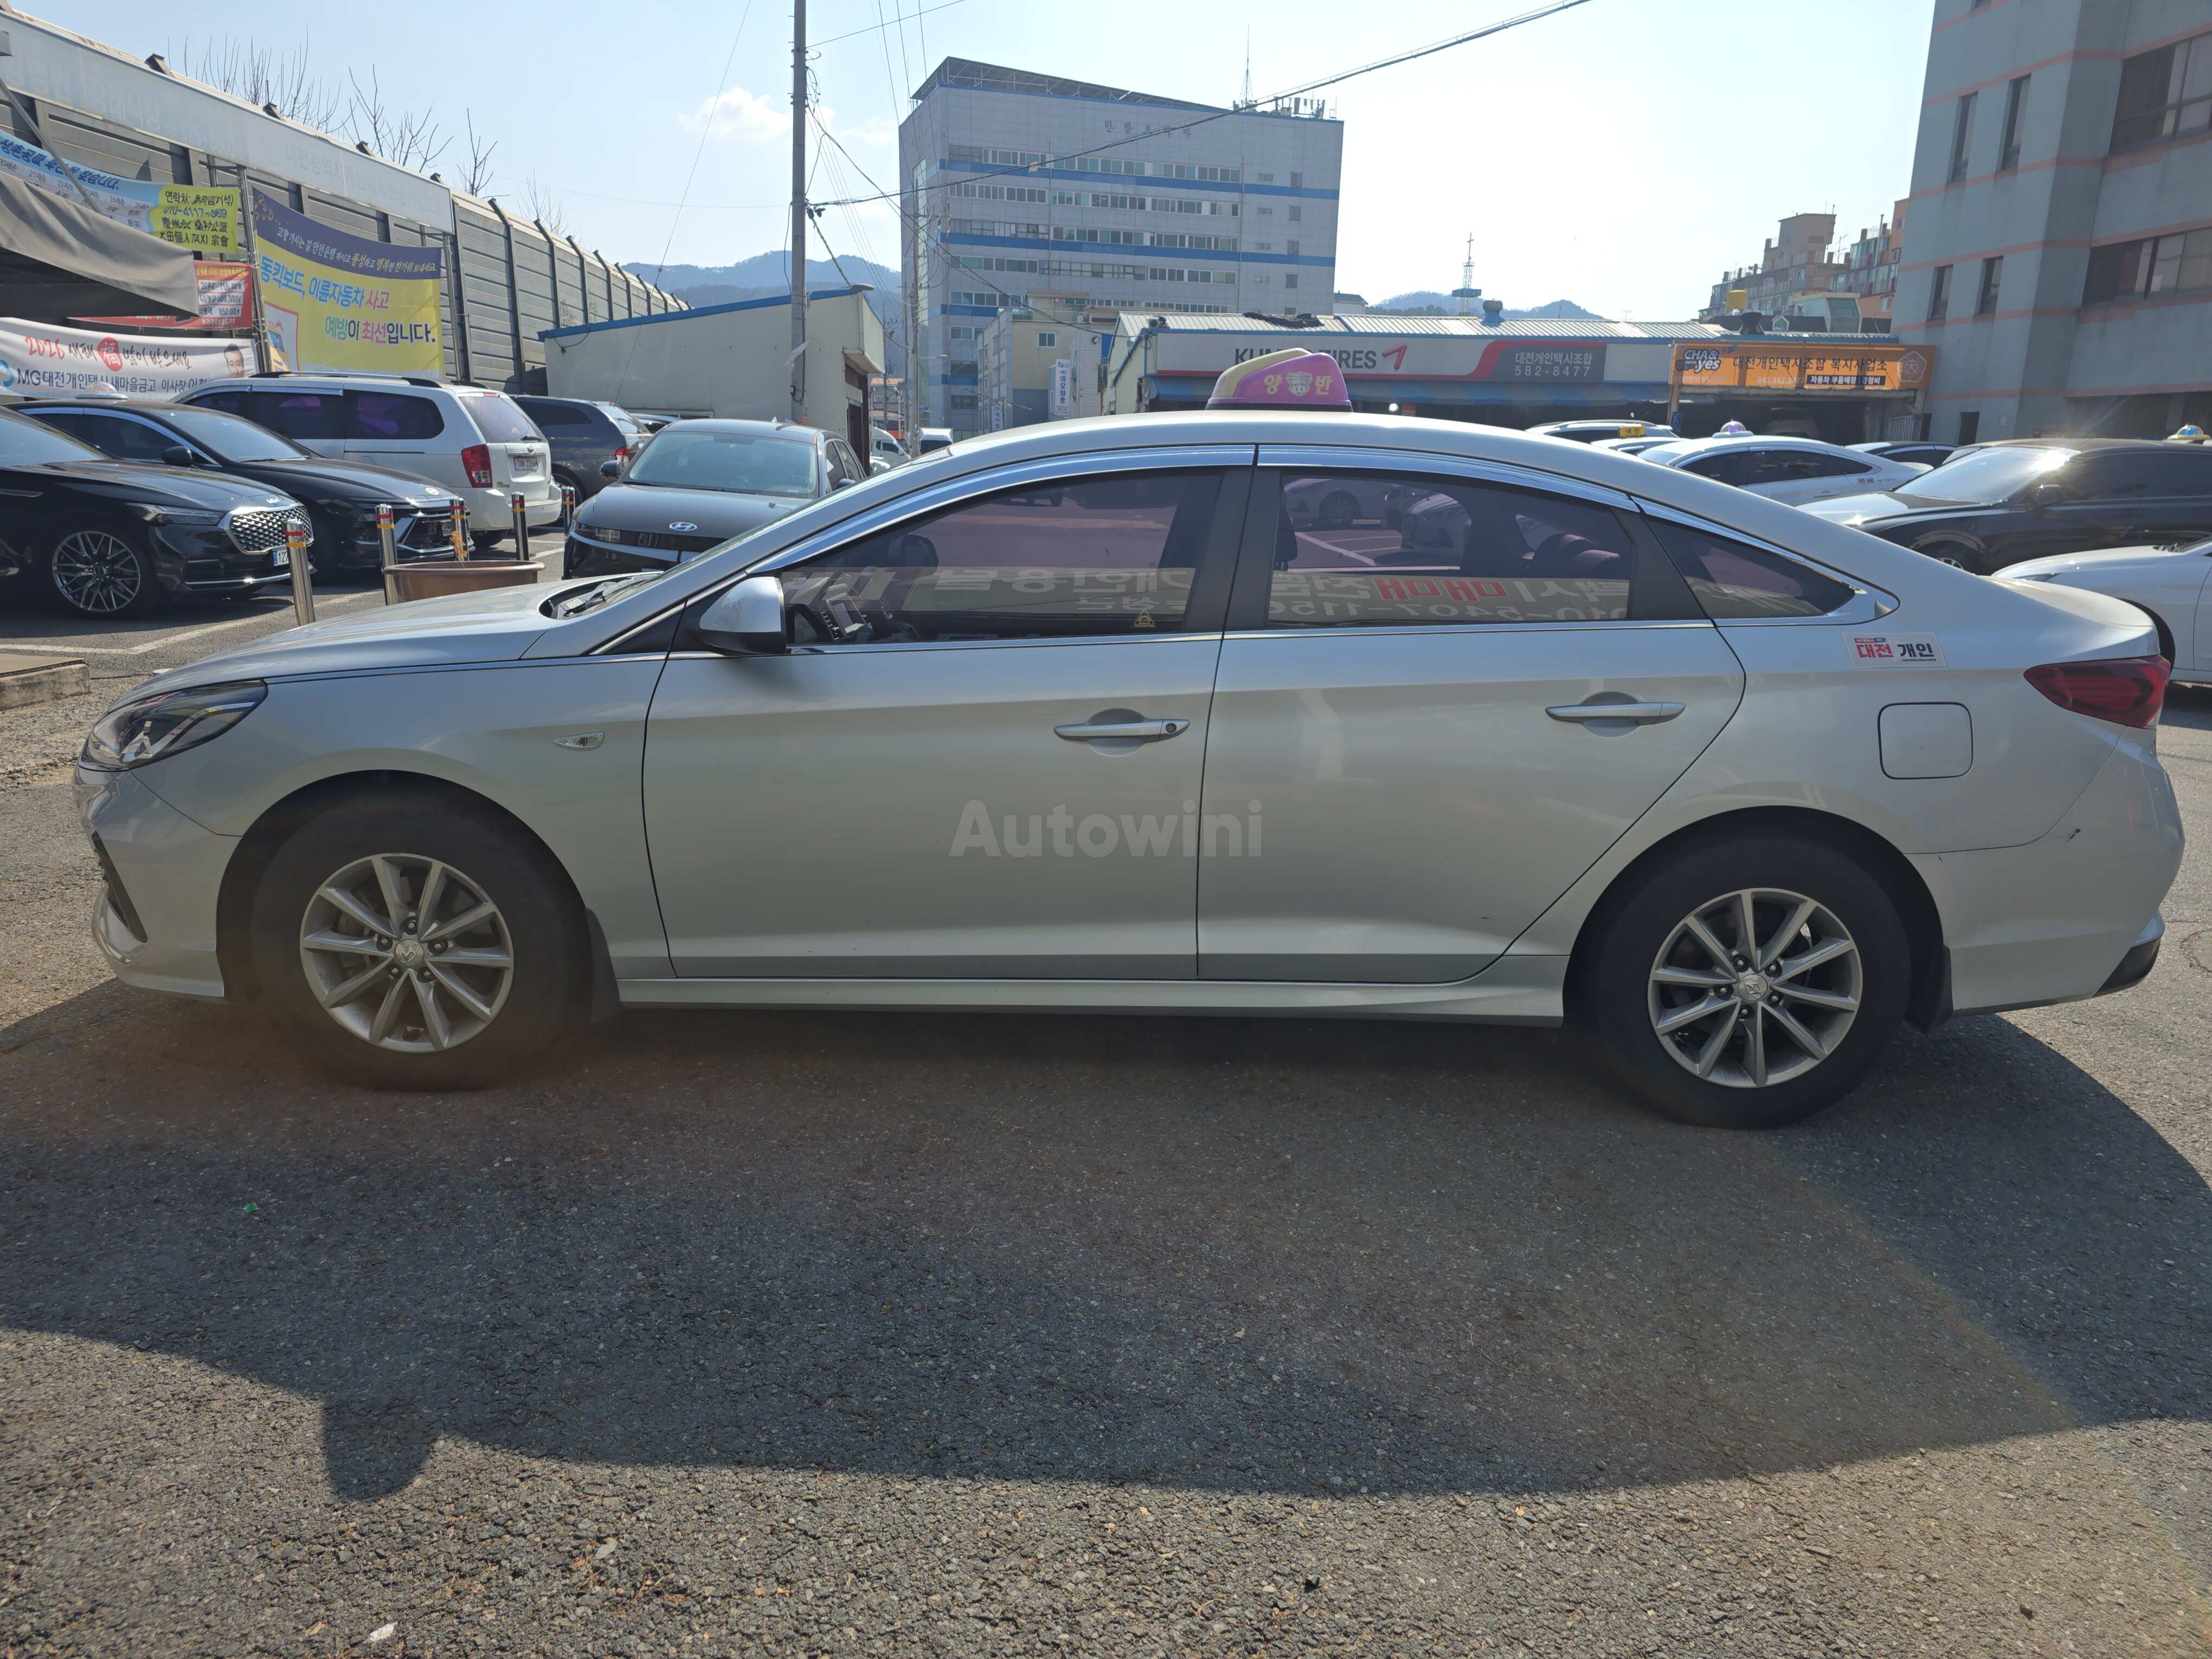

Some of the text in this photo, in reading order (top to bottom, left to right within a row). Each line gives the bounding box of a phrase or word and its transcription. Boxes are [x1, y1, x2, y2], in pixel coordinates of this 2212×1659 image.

[191, 234, 208, 245] TAXI
[308, 276, 365, 308] 이륜자동차
[365, 290, 390, 310] 사고
[325, 316, 436, 344] 예방이 최선입니다.
[25, 336, 65, 360] 2026
[68, 343, 98, 362] 새해
[1515, 351, 1593, 365] 대전개인택시조합
[1733, 356, 1887, 371] 대전개인택시조합 복지사업소
[1514, 365, 1591, 377] 582-8477
[1264, 374, 1333, 395] 양 반
[1856, 643, 1934, 658] 대전 개인
